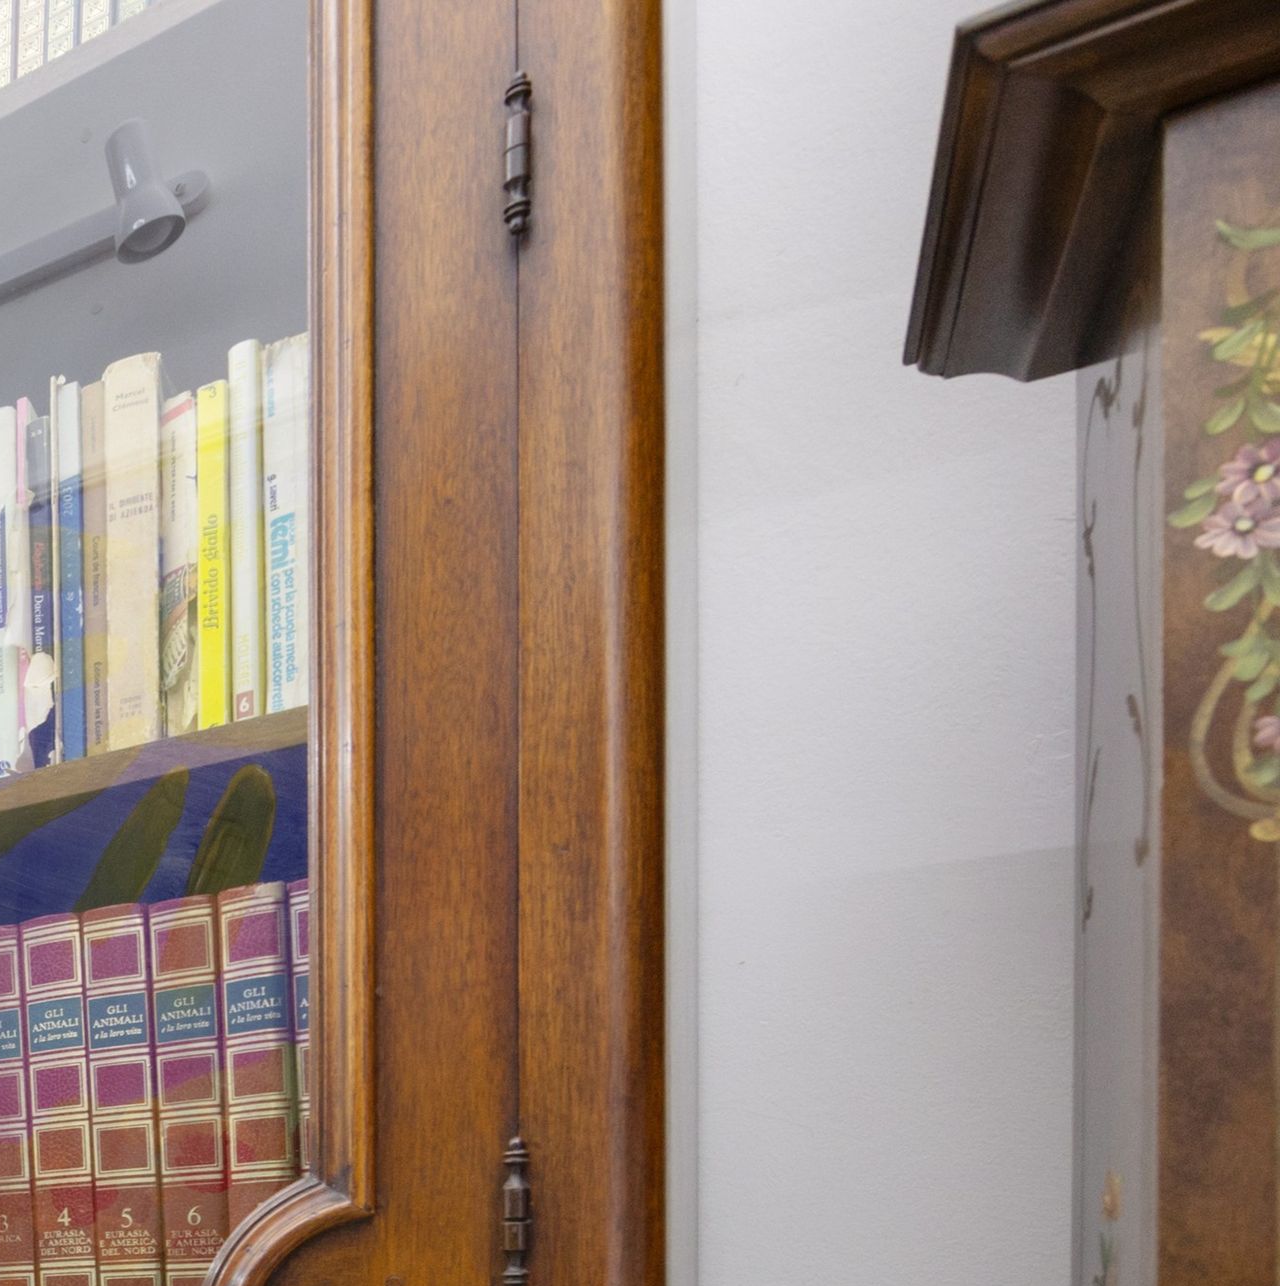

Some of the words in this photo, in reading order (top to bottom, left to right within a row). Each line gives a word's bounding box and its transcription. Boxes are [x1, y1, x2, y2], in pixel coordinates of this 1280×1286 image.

[63, 485, 74, 517] 2003
[270, 512, 297, 570] temi
[92, 535, 102, 562] Cours
[92, 563, 102, 573] de
[271, 572, 281, 596] con
[282, 567, 295, 590] per
[201, 567, 220, 630] Brivido
[285, 591, 297, 603] la
[33, 594, 45, 624] Dacia
[271, 597, 287, 640] schede
[286, 603, 298, 642] scuola
[286, 643, 300, 683] media
[238, 696, 251, 713] 6
[243, 986, 266, 998] GLI
[173, 997, 194, 1008] GLI
[229, 997, 282, 1014] ANIMALI
[45, 1008, 63, 1019] GLI
[107, 1004, 128, 1015] GLI
[160, 1006, 211, 1022] ANIMALI
[92, 1014, 143, 1029] ANIMALI
[237, 1015, 246, 1024] la
[246, 1013, 263, 1022] loro
[264, 1011, 281, 1020] vita
[32, 1018, 79, 1033] ANIMALI
[167, 1024, 175, 1033] la
[176, 1022, 192, 1031] loro
[193, 1020, 210, 1029] vita
[39, 1035, 47, 1043] la
[47, 1033, 61, 1042] loro
[62, 1031, 78, 1040] vita
[100, 1031, 108, 1039] la
[109, 1028, 125, 1037] loro
[126, 1027, 142, 1036] vita
[1, 1042, 16, 1050] vita
[57, 1207, 72, 1226] 4
[120, 1207, 134, 1229] 5
[187, 1205, 202, 1226] 6
[0, 1214, 9, 1233] 3
[44, 1229, 86, 1238] EURASIA
[105, 1229, 151, 1239] EURASIA
[170, 1228, 219, 1239] EURASIA
[47, 1237, 93, 1247] AMERICA
[99, 1239, 105, 1248] E
[111, 1238, 158, 1248] AMERICA
[176, 1237, 225, 1247] AMERICA
[40, 1246, 58, 1256] DEL
[62, 1245, 92, 1256] NORD
[101, 1248, 121, 1257] DEL
[124, 1246, 156, 1256] NORD
[167, 1248, 186, 1257] DEL
